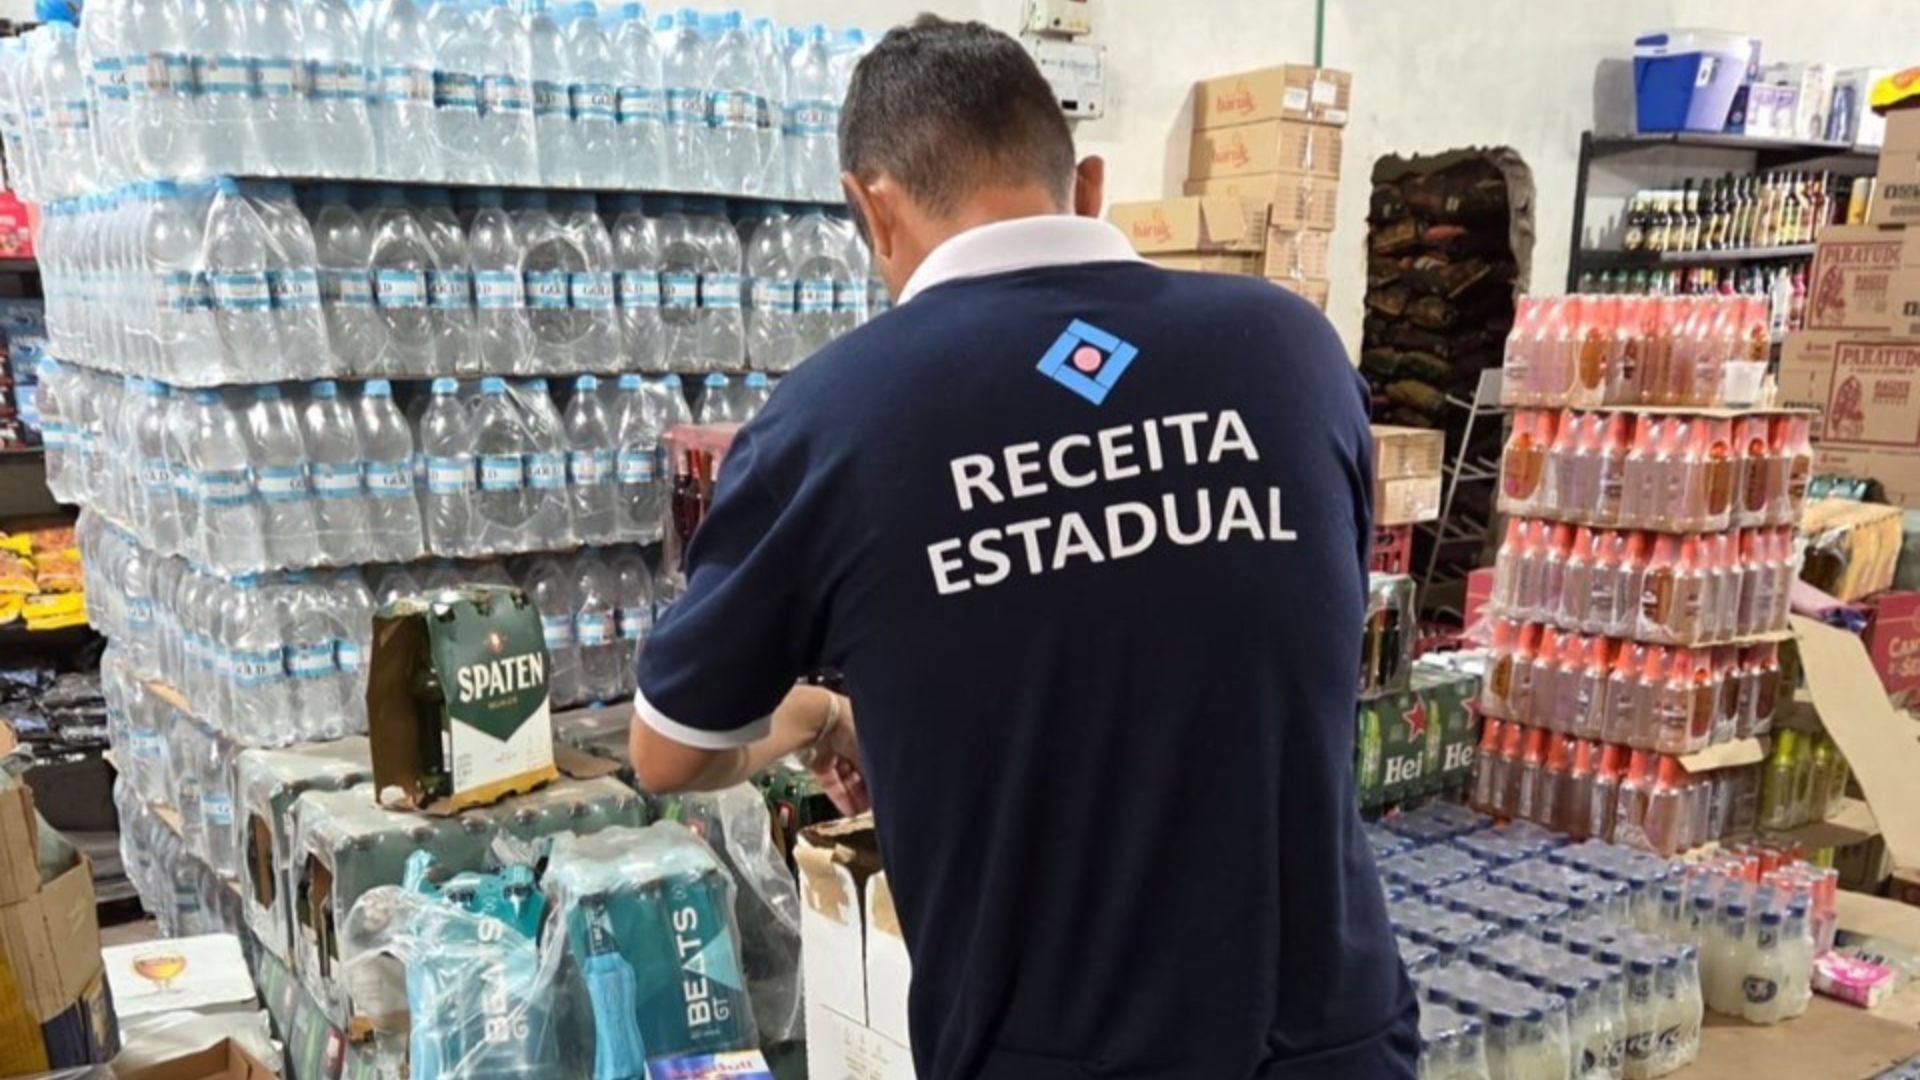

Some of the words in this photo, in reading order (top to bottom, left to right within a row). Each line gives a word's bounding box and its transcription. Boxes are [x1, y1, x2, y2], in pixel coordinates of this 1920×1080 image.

[950, 409, 1259, 511] RECEITA
[927, 487, 1297, 595] ESTADUAL
[457, 652, 544, 703] SPATEN
[673, 906, 712, 1028] BEATS
[713, 996, 730, 1021] GT
